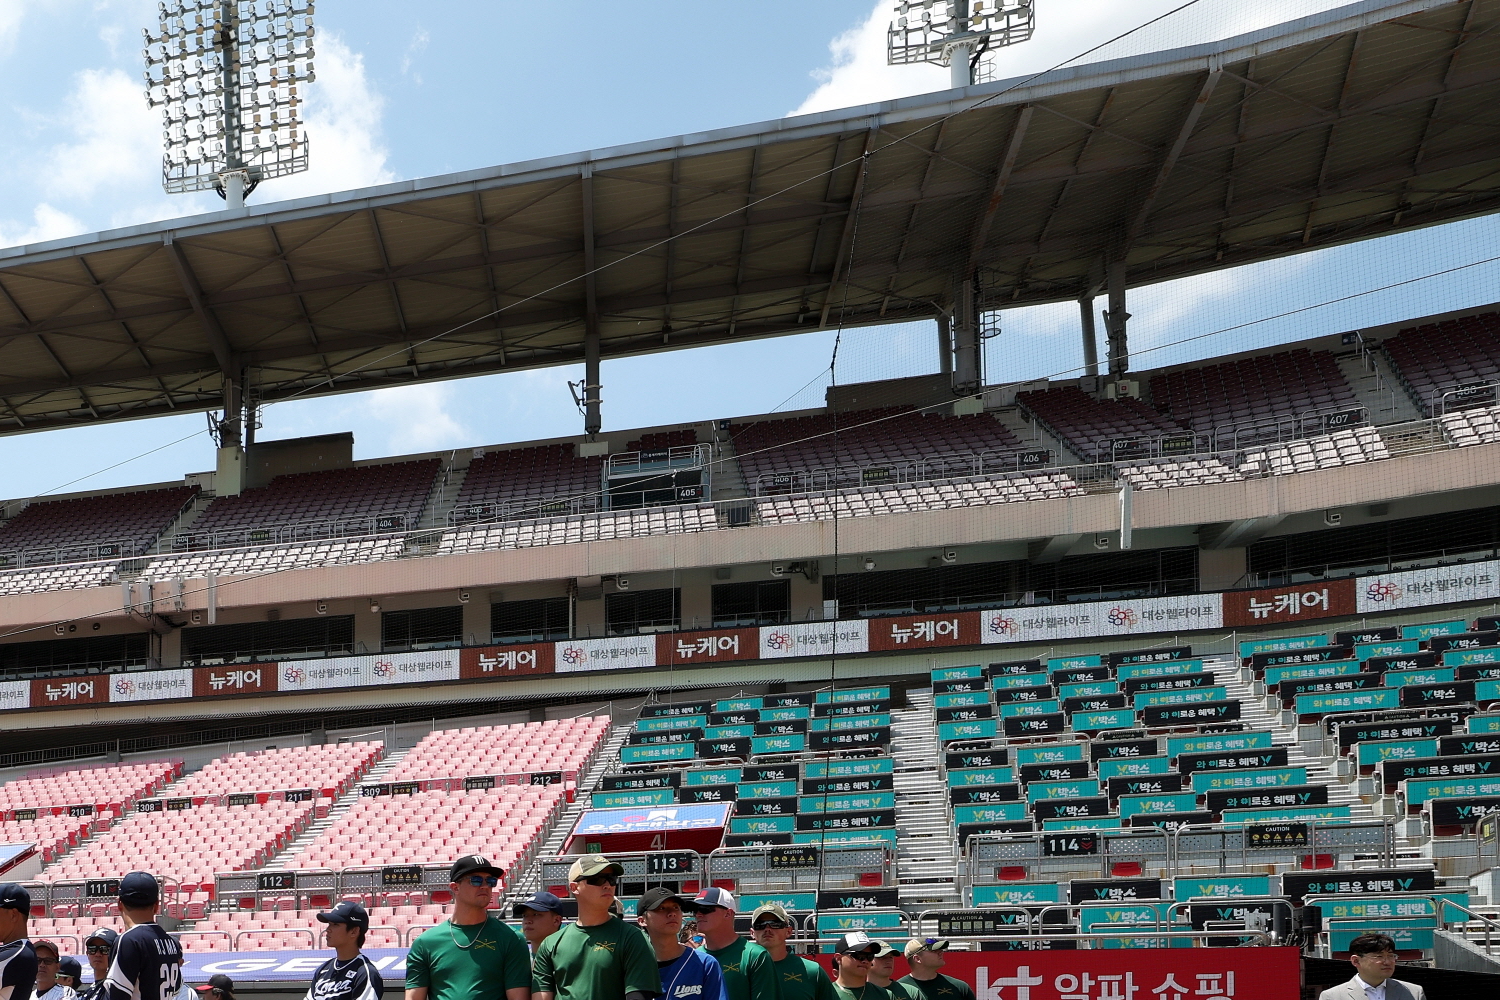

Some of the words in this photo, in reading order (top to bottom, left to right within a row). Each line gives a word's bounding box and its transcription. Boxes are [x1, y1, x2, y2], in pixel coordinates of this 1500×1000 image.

[1249, 588, 1329, 619] 뉴케어
[891, 619, 959, 642] 뉴케어
[676, 635, 739, 657] 뉴케어
[479, 649, 537, 671] 뉴케어
[209, 668, 261, 690] 뉴케어
[46, 681, 94, 701] 뉴케어
[1198, 707, 1216, 717] 혜택
[1452, 762, 1475, 774] 혜택
[534, 775, 551, 786] 212
[287, 792, 303, 802] 211
[363, 787, 380, 798] 309
[71, 807, 85, 816] 210
[140, 802, 155, 812] 308
[650, 834, 663, 850] 4
[1050, 839, 1079, 851] 114
[653, 858, 677, 869] 113
[263, 876, 282, 887] 112
[1367, 879, 1394, 891] 혜택
[90, 884, 107, 894] 111
[1395, 903, 1426, 915] 혜택
[314, 978, 351, 997] Korea
[674, 985, 702, 996] Lions
